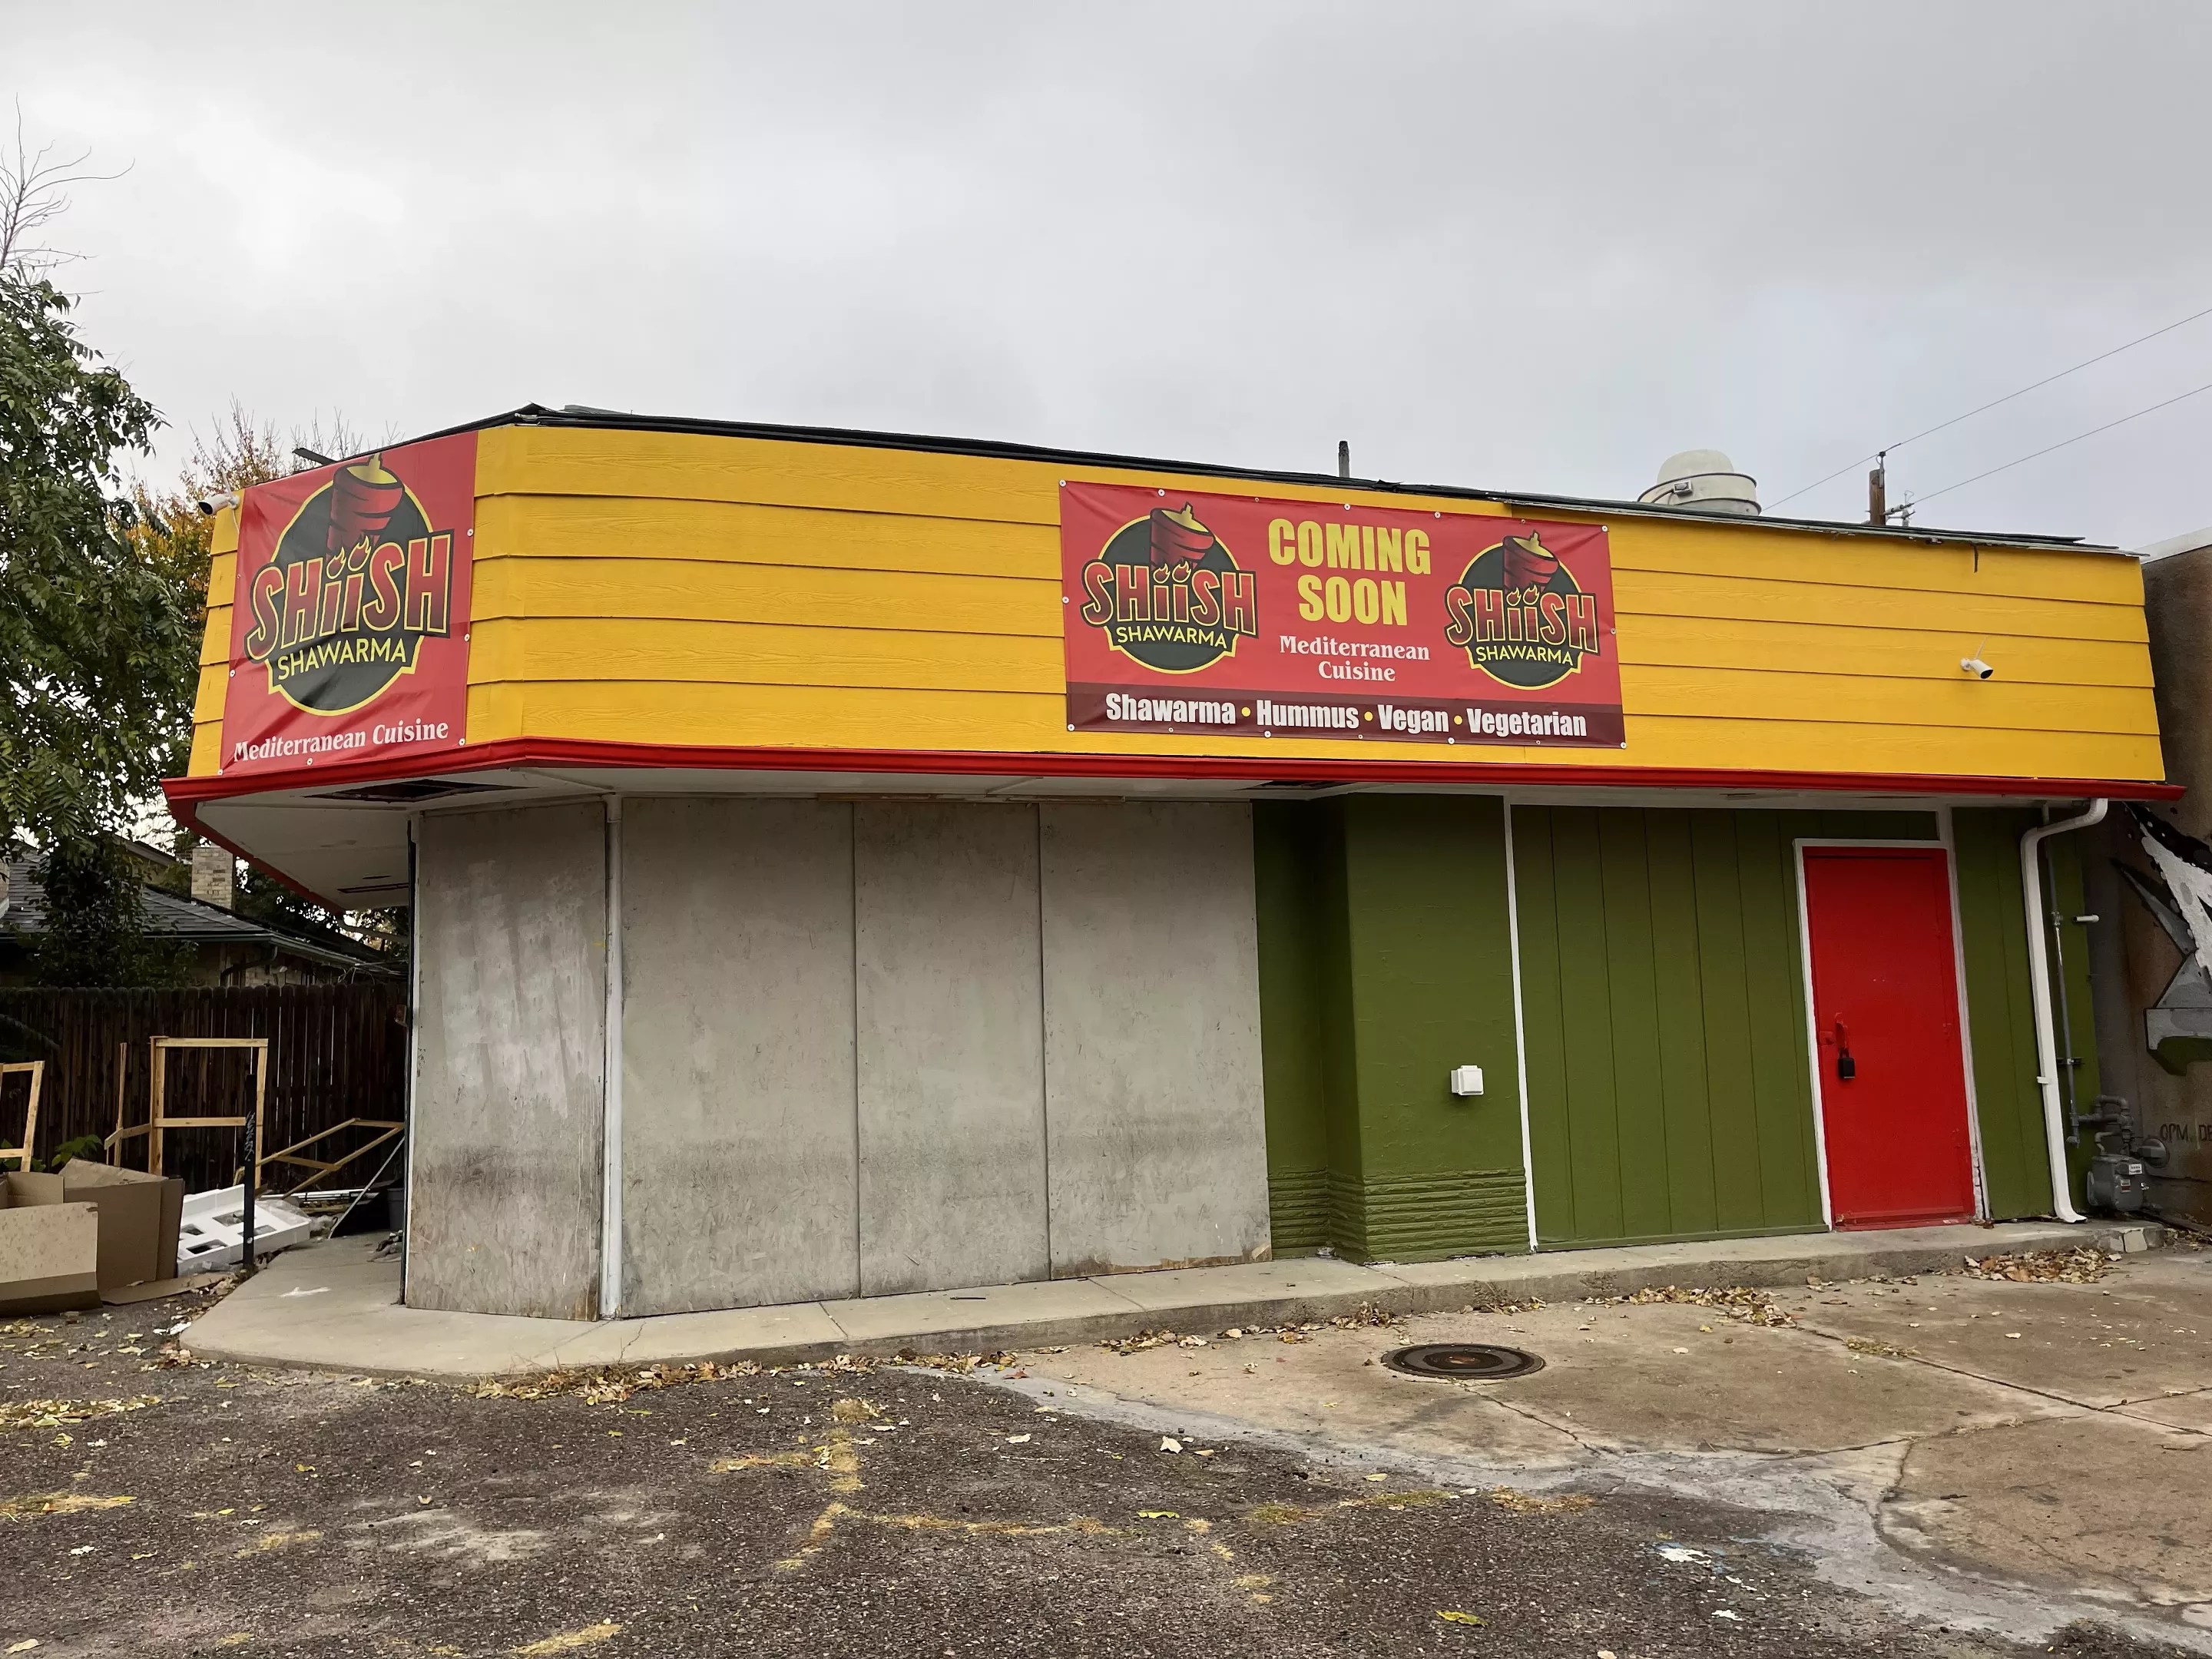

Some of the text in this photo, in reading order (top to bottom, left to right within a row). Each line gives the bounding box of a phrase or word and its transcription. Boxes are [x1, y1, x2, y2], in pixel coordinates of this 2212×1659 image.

[1268, 518, 1431, 575] COMING
[1297, 575, 1408, 626] SOON
[277, 637, 406, 680] SHAWARMA
[1116, 625, 1227, 649] SHAWARMA
[1280, 635, 1430, 661] Mediterranean
[1475, 645, 1573, 666] SHAWARMA
[1318, 661, 1396, 682] Cuisine
[1105, 693, 1588, 737] Shawarma Hummus Vegan Vegetarian
[233, 717, 449, 763] Mediterranean Cuisine
